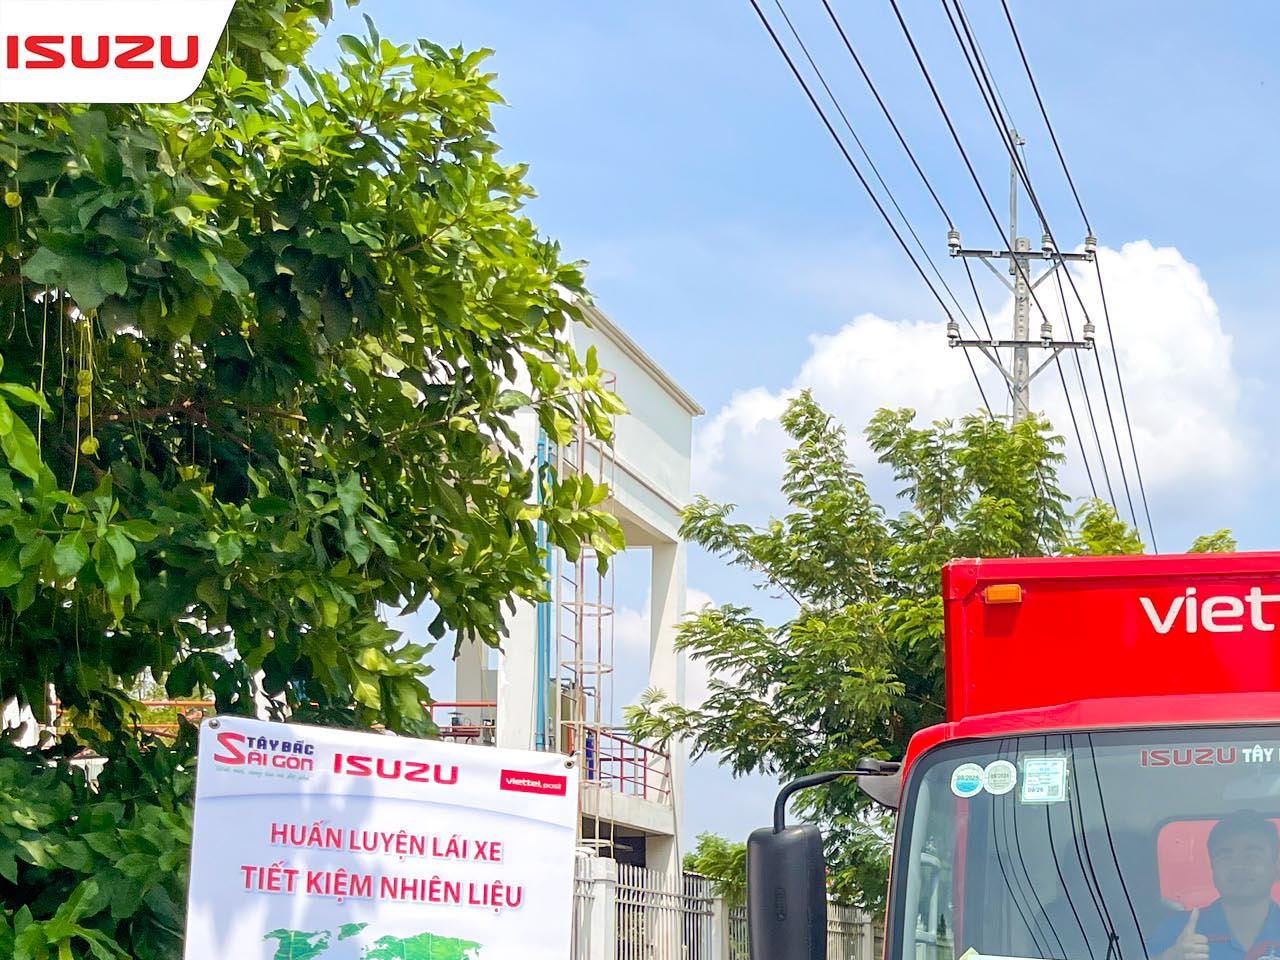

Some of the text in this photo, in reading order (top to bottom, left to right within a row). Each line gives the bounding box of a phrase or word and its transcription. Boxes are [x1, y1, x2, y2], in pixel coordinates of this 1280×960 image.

[247, 736, 314, 755] TÂY BẮC
[1140, 747, 1236, 767] ISUZU
[1242, 745, 1273, 763] TÂY
[333, 754, 458, 785] ISUZU
[271, 820, 501, 861] HUẤN LUYỆN LÁI XE
[241, 861, 522, 913] TIẾT KIỆM NHIÊN LIỆU
